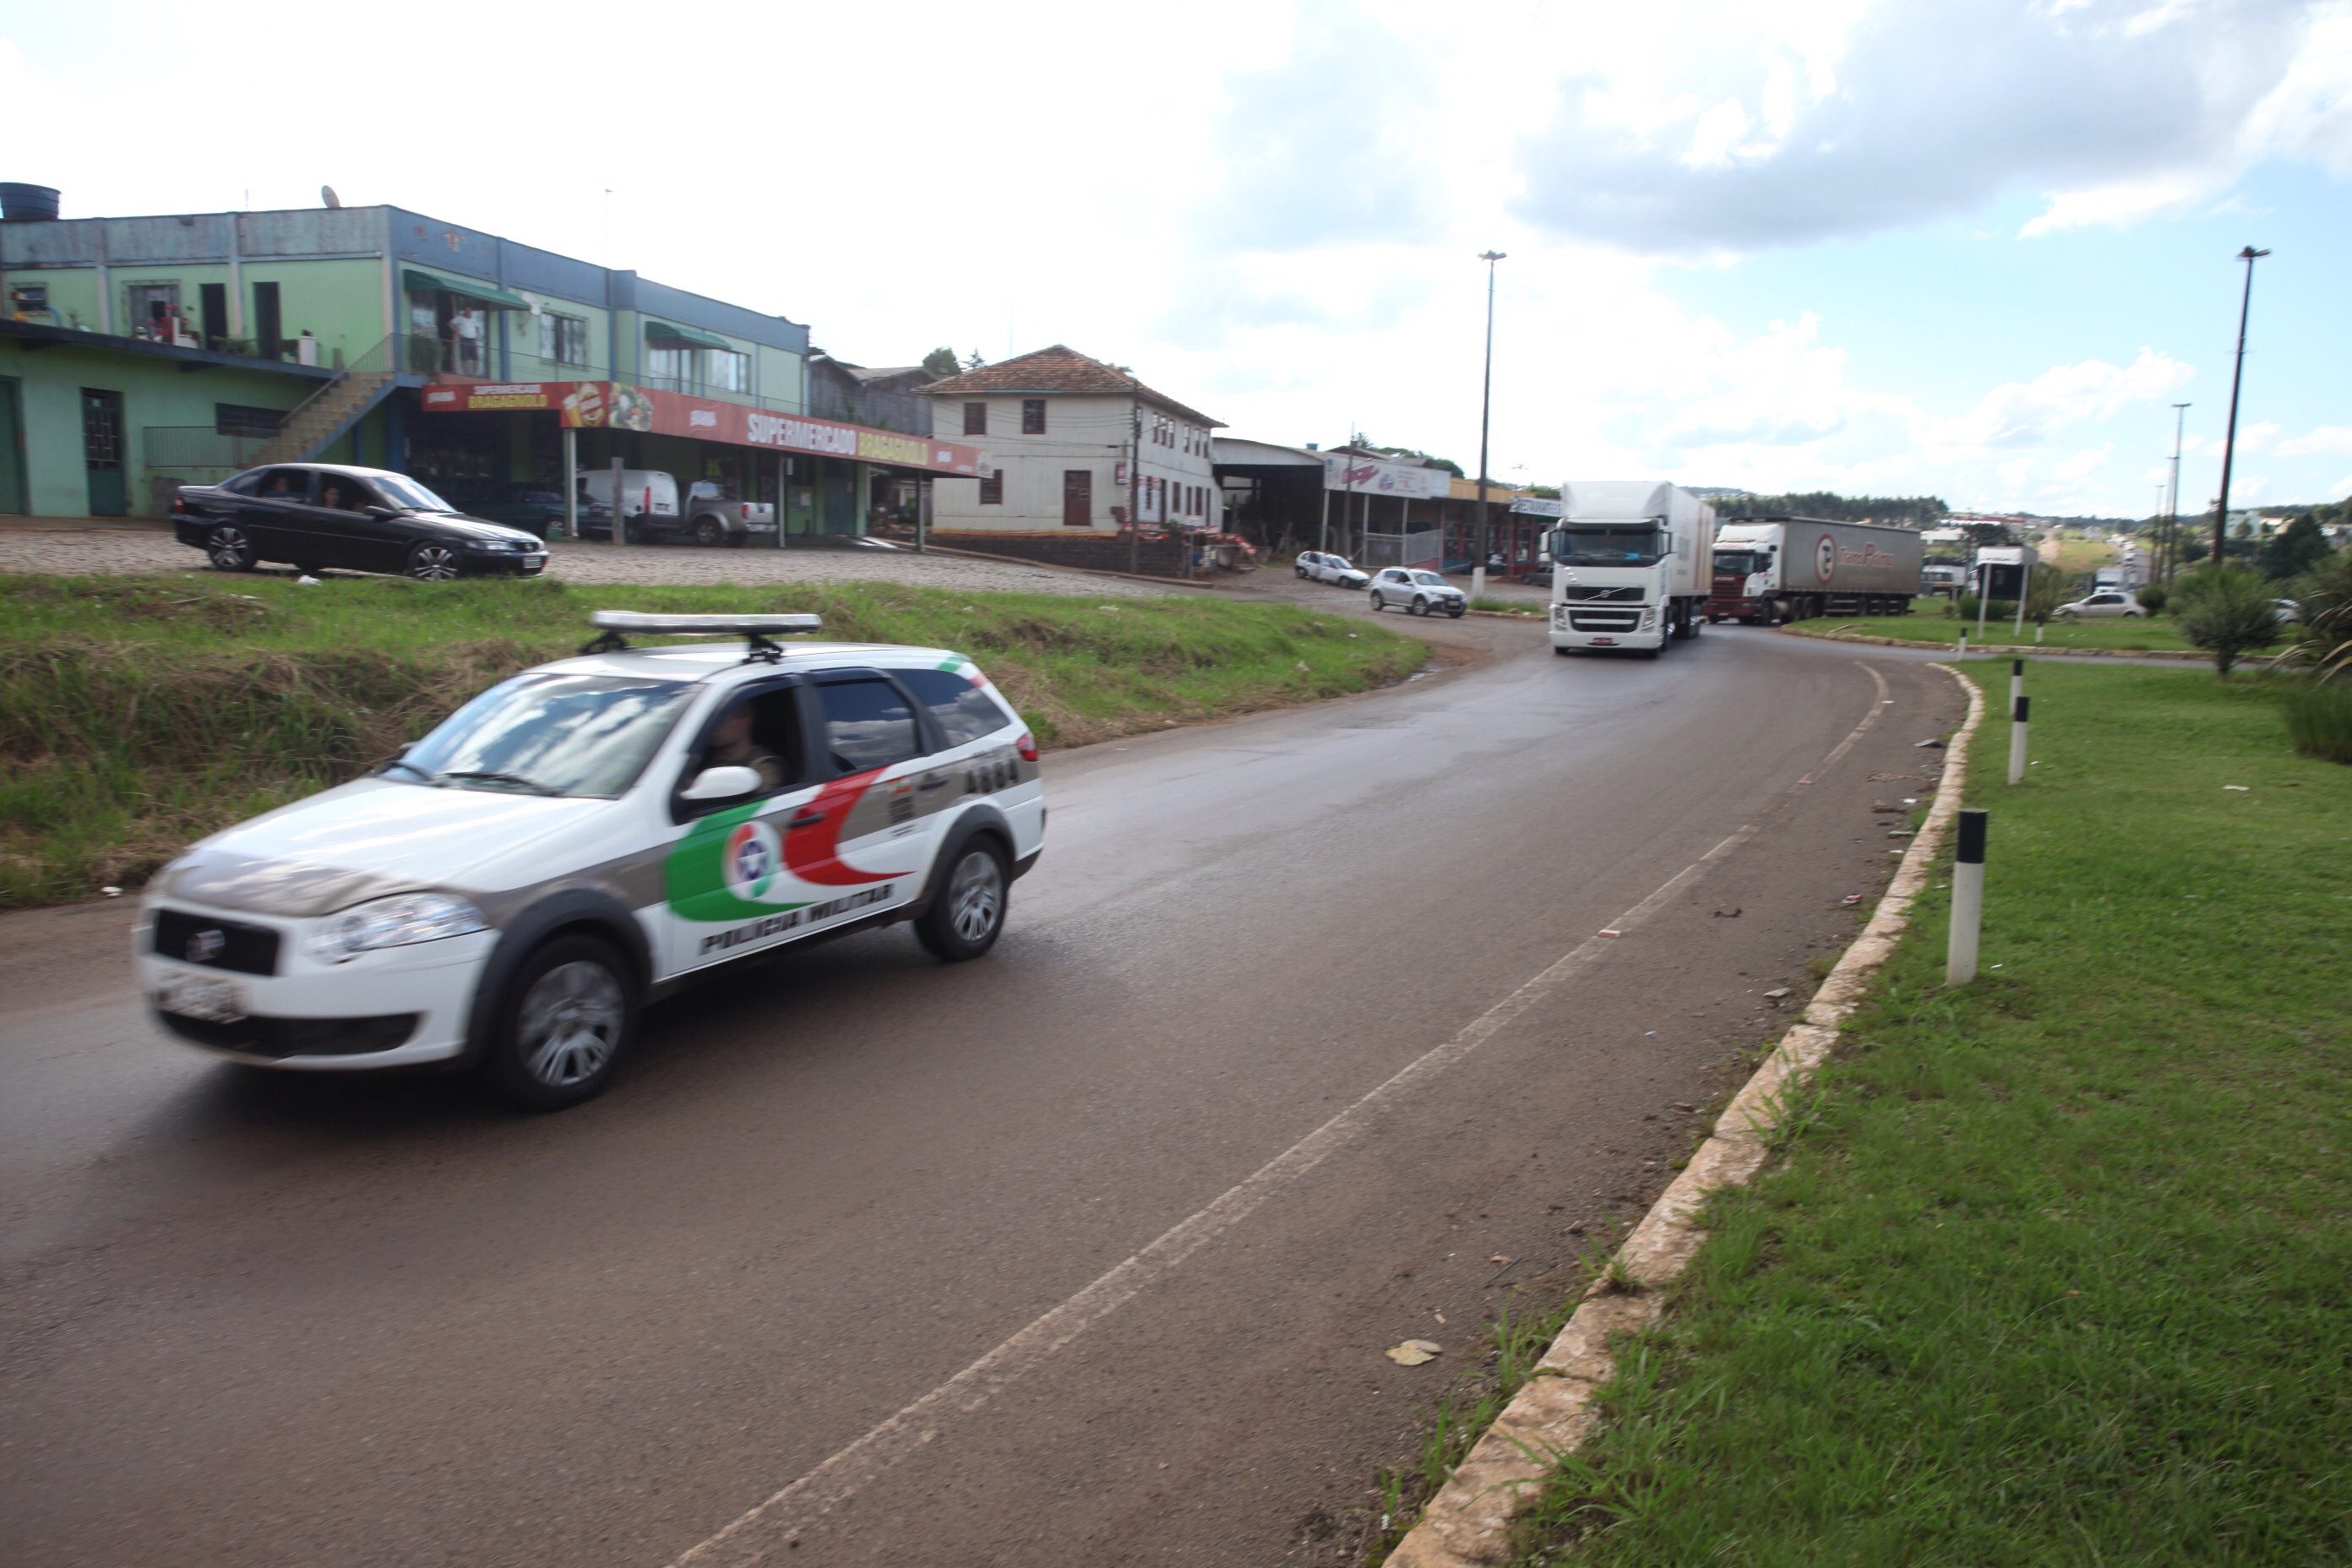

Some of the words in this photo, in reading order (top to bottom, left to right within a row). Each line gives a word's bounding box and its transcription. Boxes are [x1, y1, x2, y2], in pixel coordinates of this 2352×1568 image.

[467, 395, 547, 409] BRAGAGNOLO
[473, 384, 542, 395] SUPERMERCADO
[747, 413, 857, 456] SUPERMERCADO
[858, 431, 928, 466] BRAGAGNOLO
[808, 883, 896, 923] MILITAR
